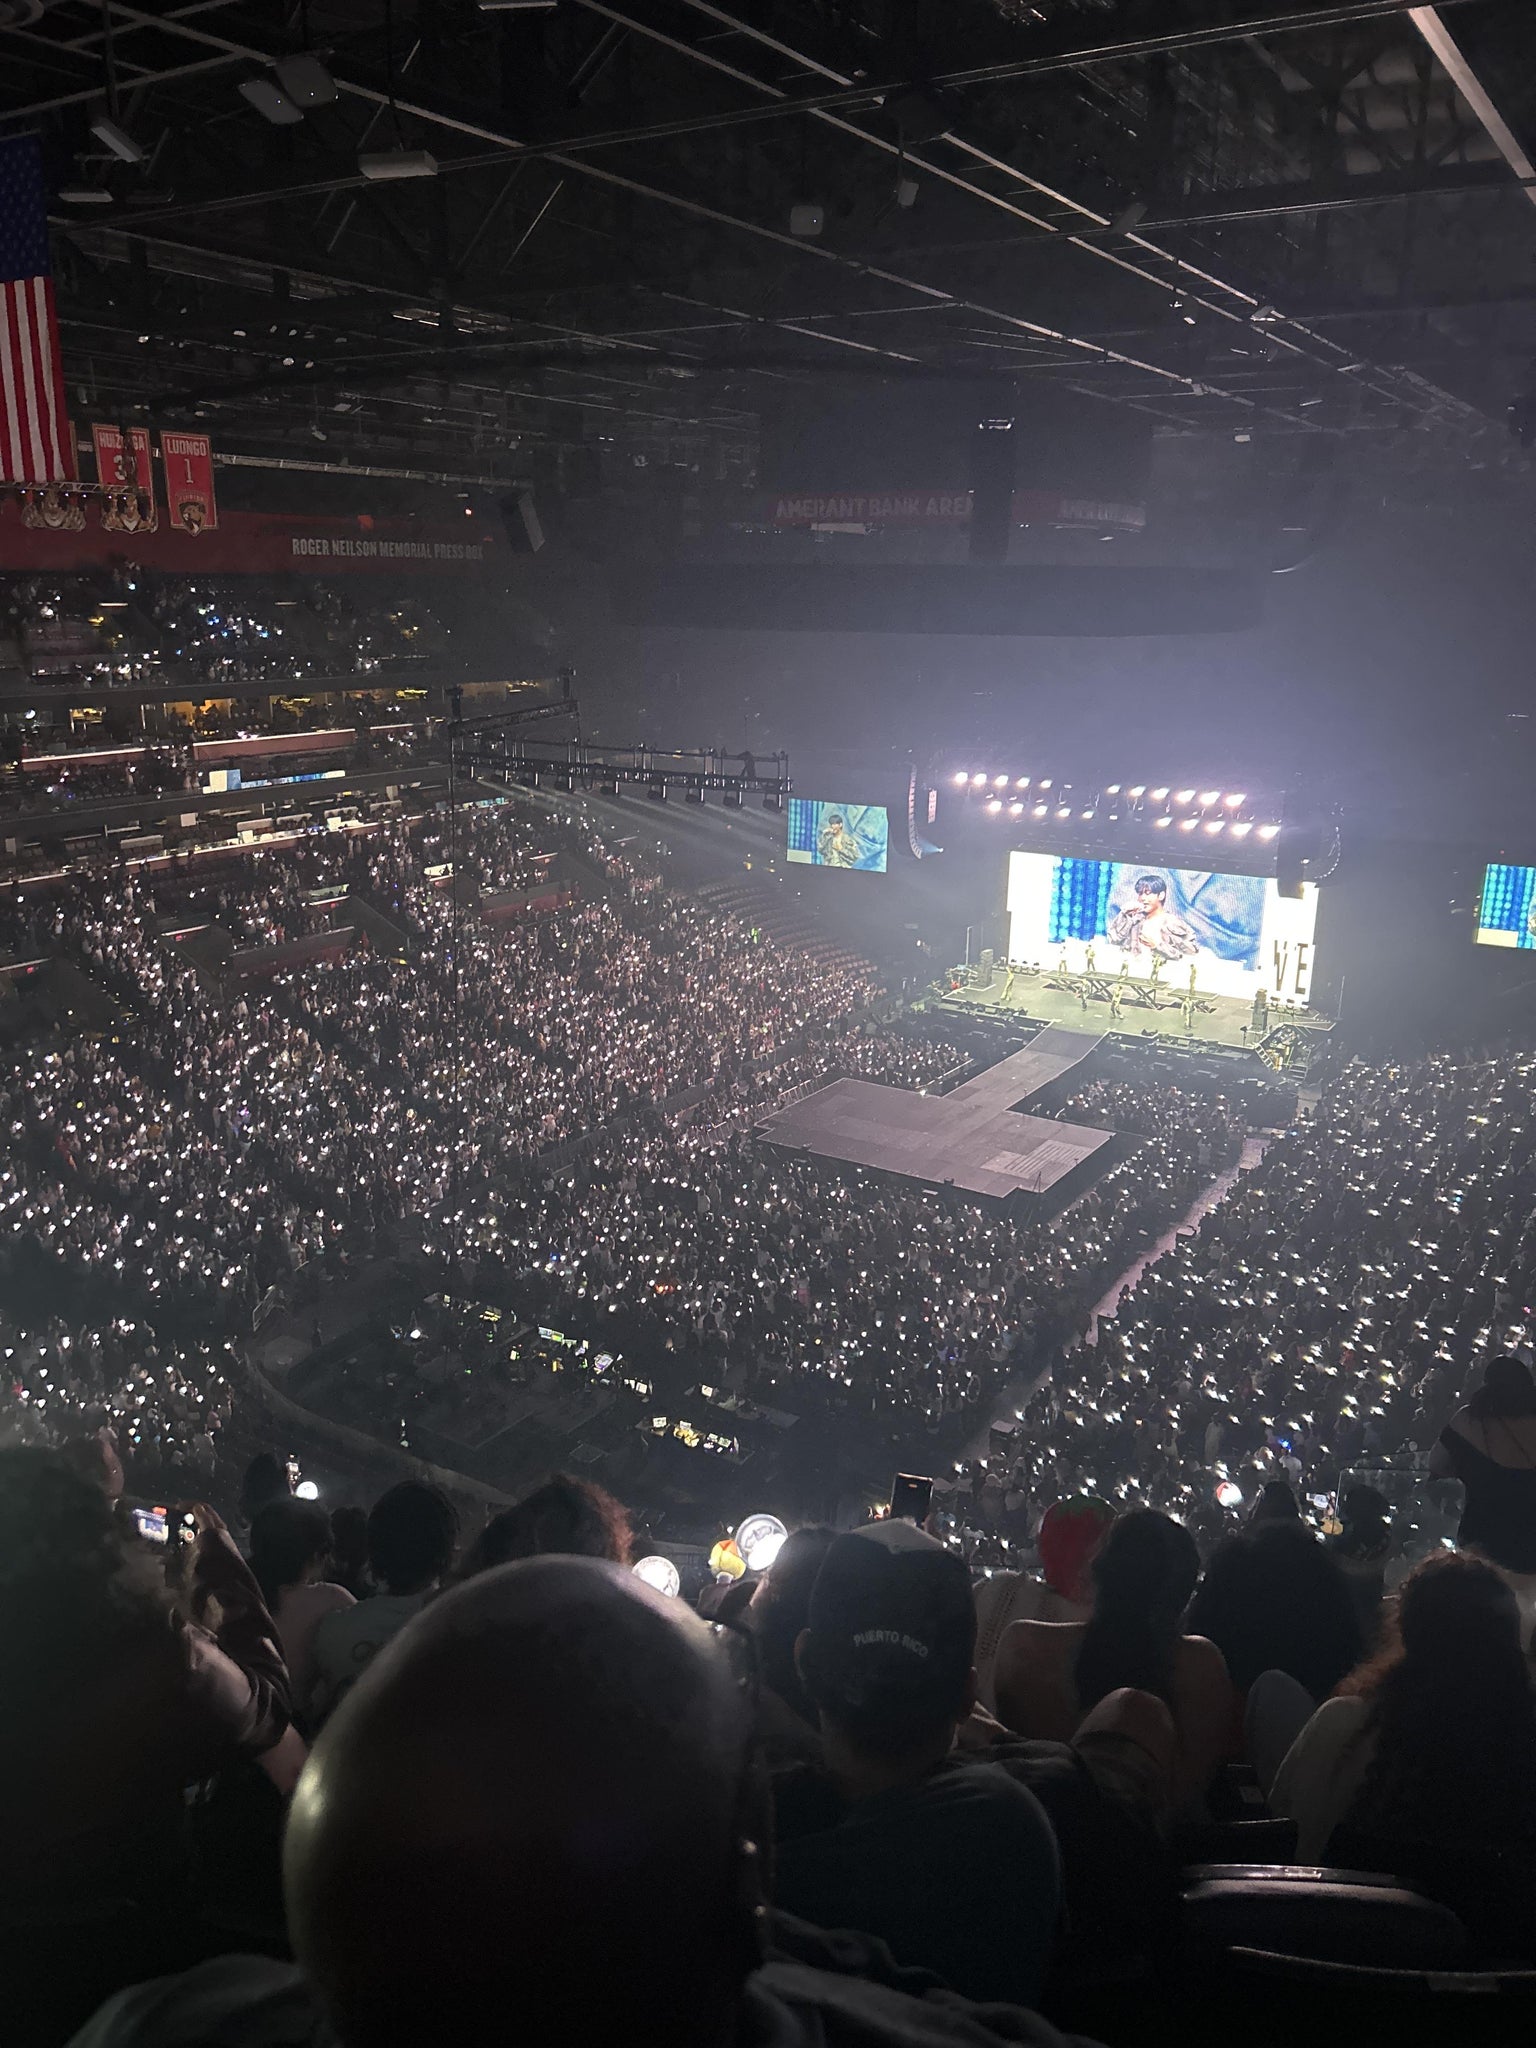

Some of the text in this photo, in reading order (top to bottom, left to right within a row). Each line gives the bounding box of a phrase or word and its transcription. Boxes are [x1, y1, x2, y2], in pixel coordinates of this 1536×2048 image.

[166, 438, 207, 457] LUONGO
[184, 458, 194, 484] 1
[776, 498, 866, 518] AMERANT
[869, 497, 920, 516] BANK
[292, 538, 330, 556] ROGER
[332, 539, 377, 557] NEILSON
[379, 541, 432, 559] MEMORIAL
[434, 543, 463, 560] PRESS
[853, 1629, 929, 1658] PUERTO RICO
